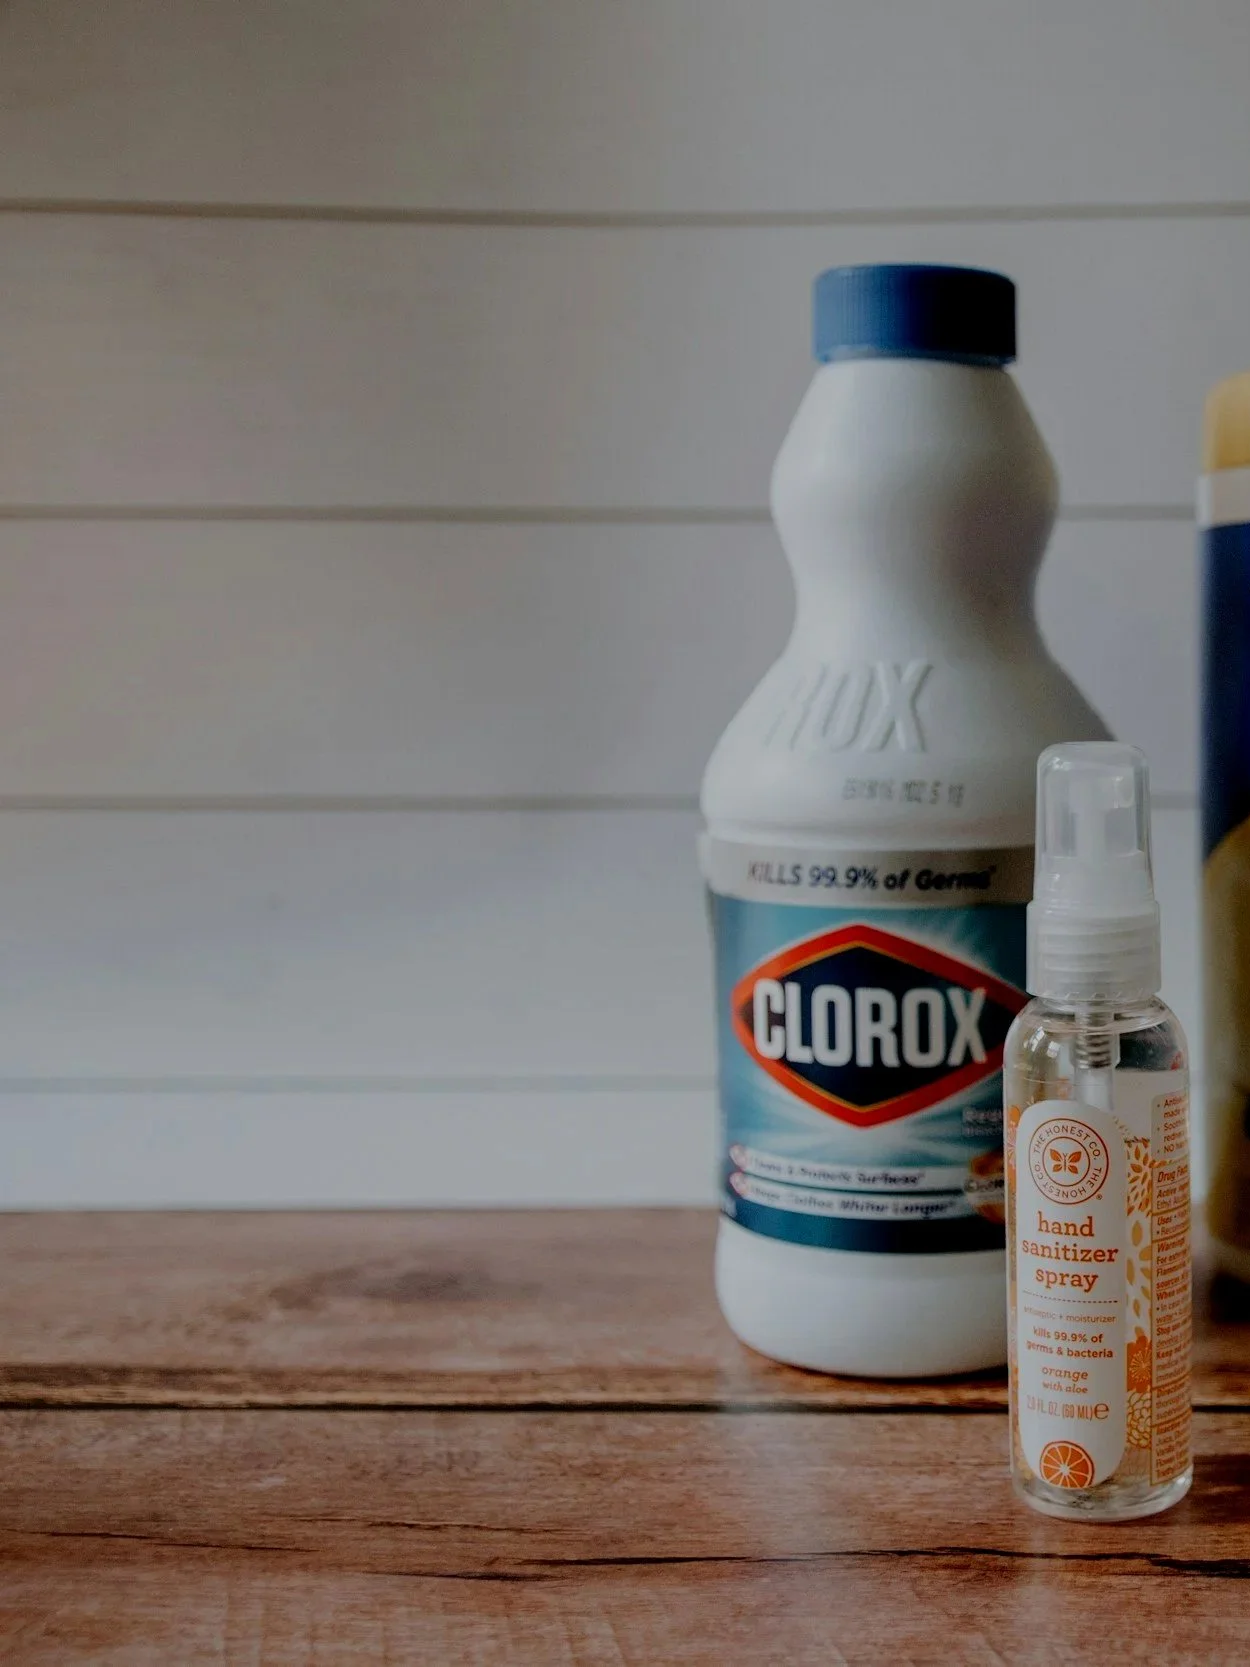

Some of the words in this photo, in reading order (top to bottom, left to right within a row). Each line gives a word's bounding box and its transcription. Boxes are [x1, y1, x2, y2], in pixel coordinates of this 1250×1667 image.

[748, 860, 801, 884] KILLS
[809, 866, 878, 889] 99.9%
[884, 868, 910, 890] of
[753, 977, 988, 1068] CLOROX
[1034, 1135, 1045, 1153] THE
[1045, 1125, 1090, 1141] HONEST
[1086, 1167, 1102, 1188] THE
[1043, 1182, 1087, 1198] HONEST
[1037, 1211, 1094, 1236] hand
[1022, 1238, 1118, 1264] sanitizer
[1035, 1268, 1099, 1293] spray
[1066, 1314, 1117, 1324] moisturizer
[1033, 1326, 1051, 1339] kills
[1054, 1331, 1088, 1342] 99.9%
[1091, 1333, 1104, 1343] of
[1026, 1340, 1053, 1354] germs
[1056, 1347, 1063, 1356] &
[1067, 1347, 1113, 1358] bacteria
[1041, 1366, 1088, 1382] orange
[1042, 1381, 1062, 1392] with
[1065, 1383, 1088, 1394] aloe
